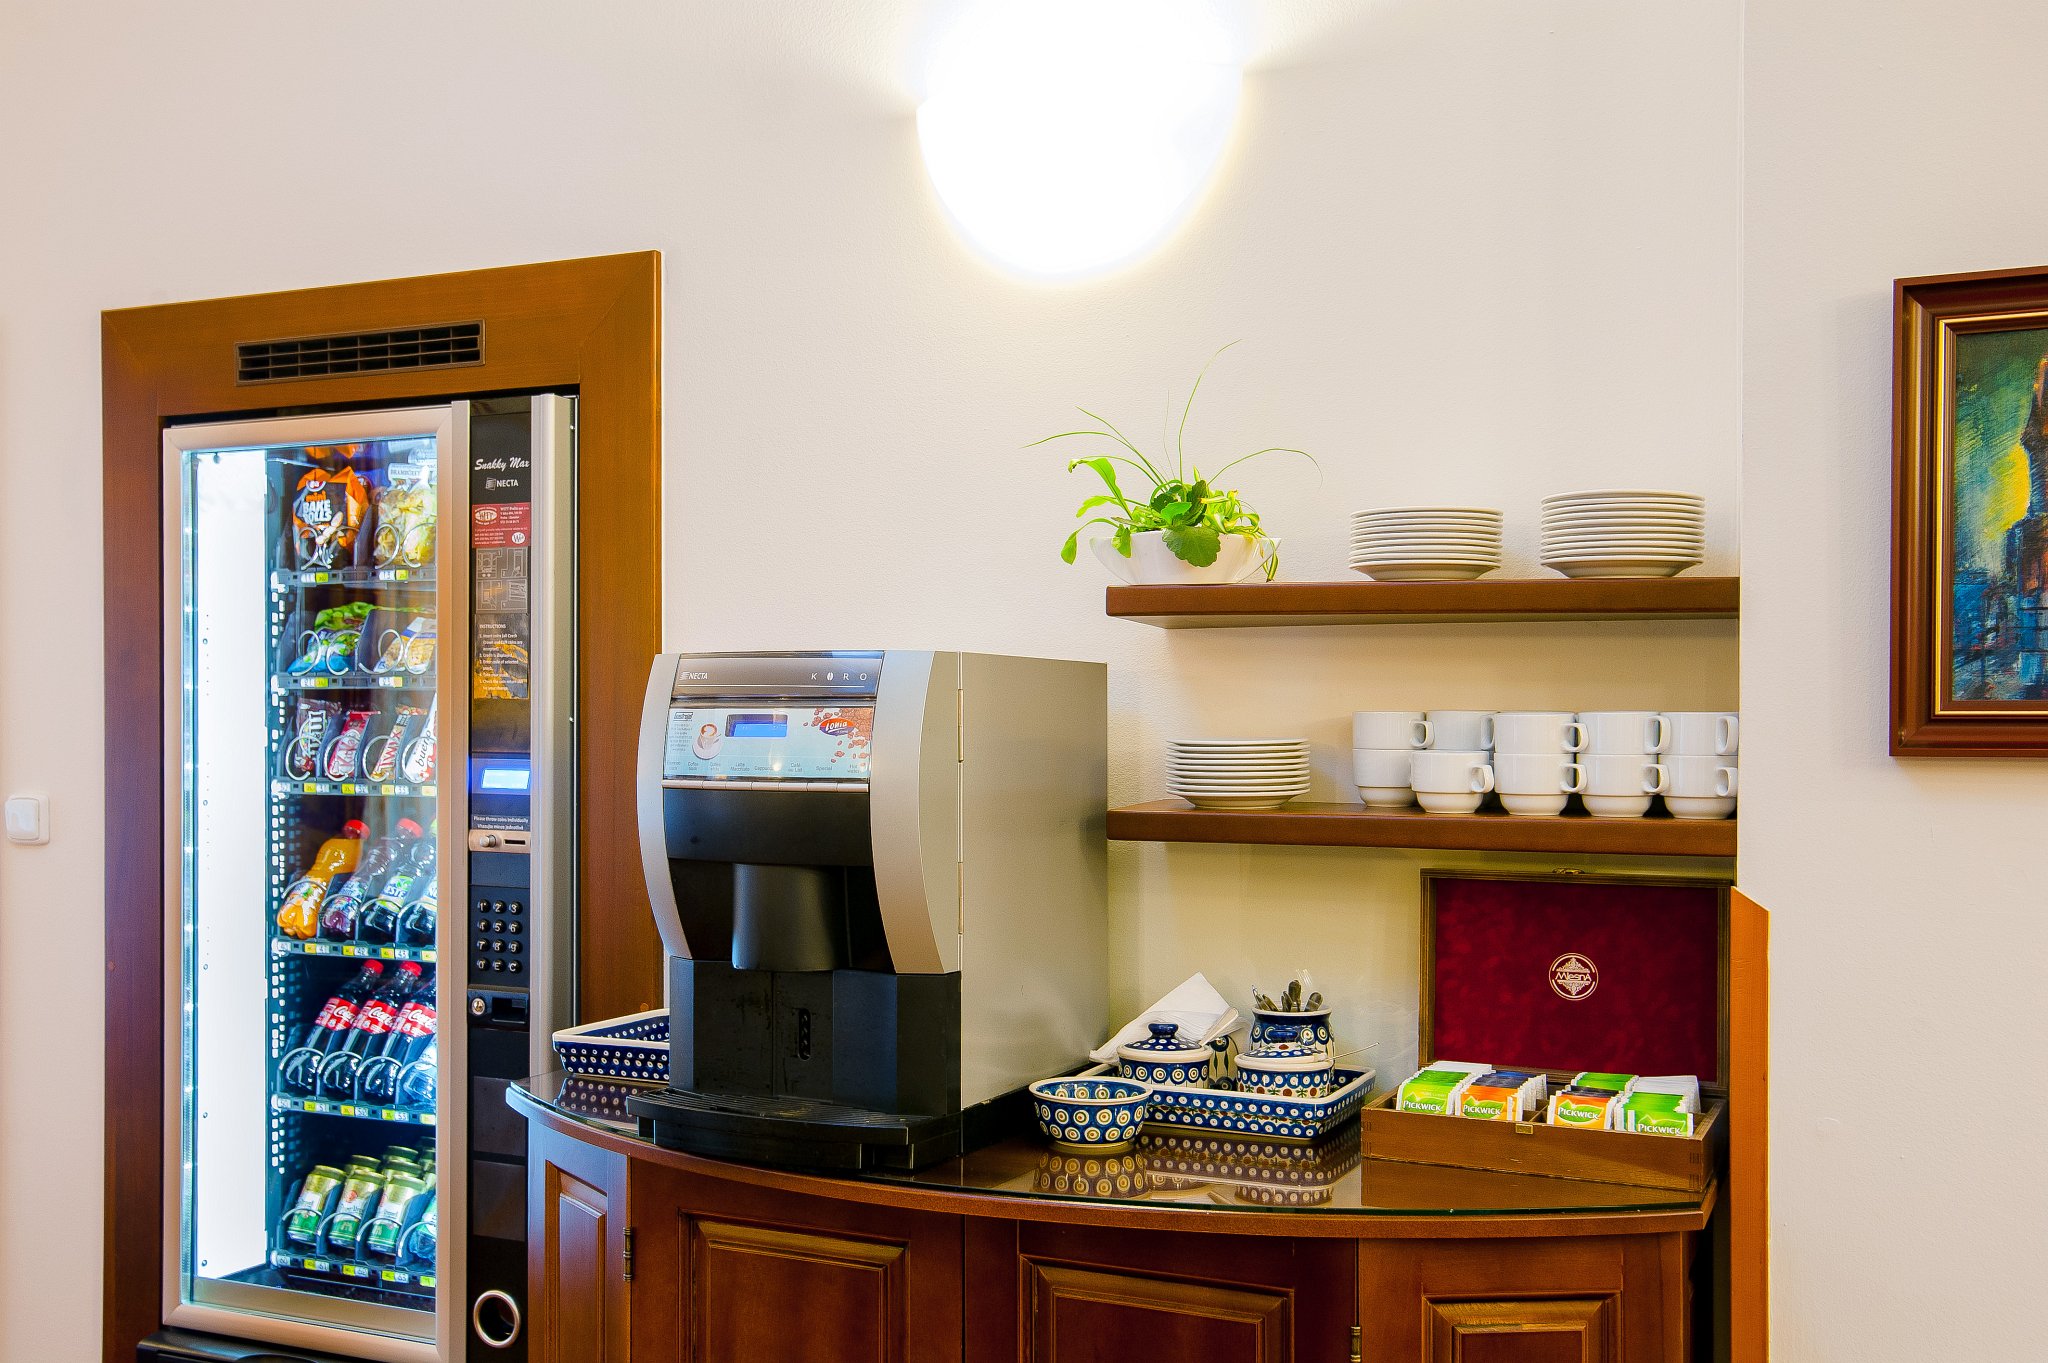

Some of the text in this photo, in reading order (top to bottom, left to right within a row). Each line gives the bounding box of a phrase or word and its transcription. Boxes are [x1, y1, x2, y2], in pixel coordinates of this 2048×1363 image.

[475, 458, 506, 471] Snakky
[496, 479, 519, 488] NECTA
[305, 490, 327, 502] mini
[303, 499, 331, 511] BAKE
[689, 672, 708, 680] NECTA
[416, 729, 432, 768] bueno
[480, 902, 484, 911] 1
[495, 903, 501, 912] 2
[511, 904, 517, 913] 3
[479, 922, 485, 930] 4
[495, 922, 501, 931] 5
[510, 923, 517, 932] 6
[479, 941, 485, 950] 7
[494, 942, 501, 951] 8
[511, 943, 517, 952] 9
[478, 960, 485, 969] 0
[494, 961, 501, 970] E
[509, 962, 517, 971] C
[1403, 1100, 1441, 1111] PICKWICK
[1463, 1104, 1500, 1115] PICKWICK
[1557, 1107, 1599, 1119] PICKWICK
[1638, 1123, 1681, 1134] PICKWICK
